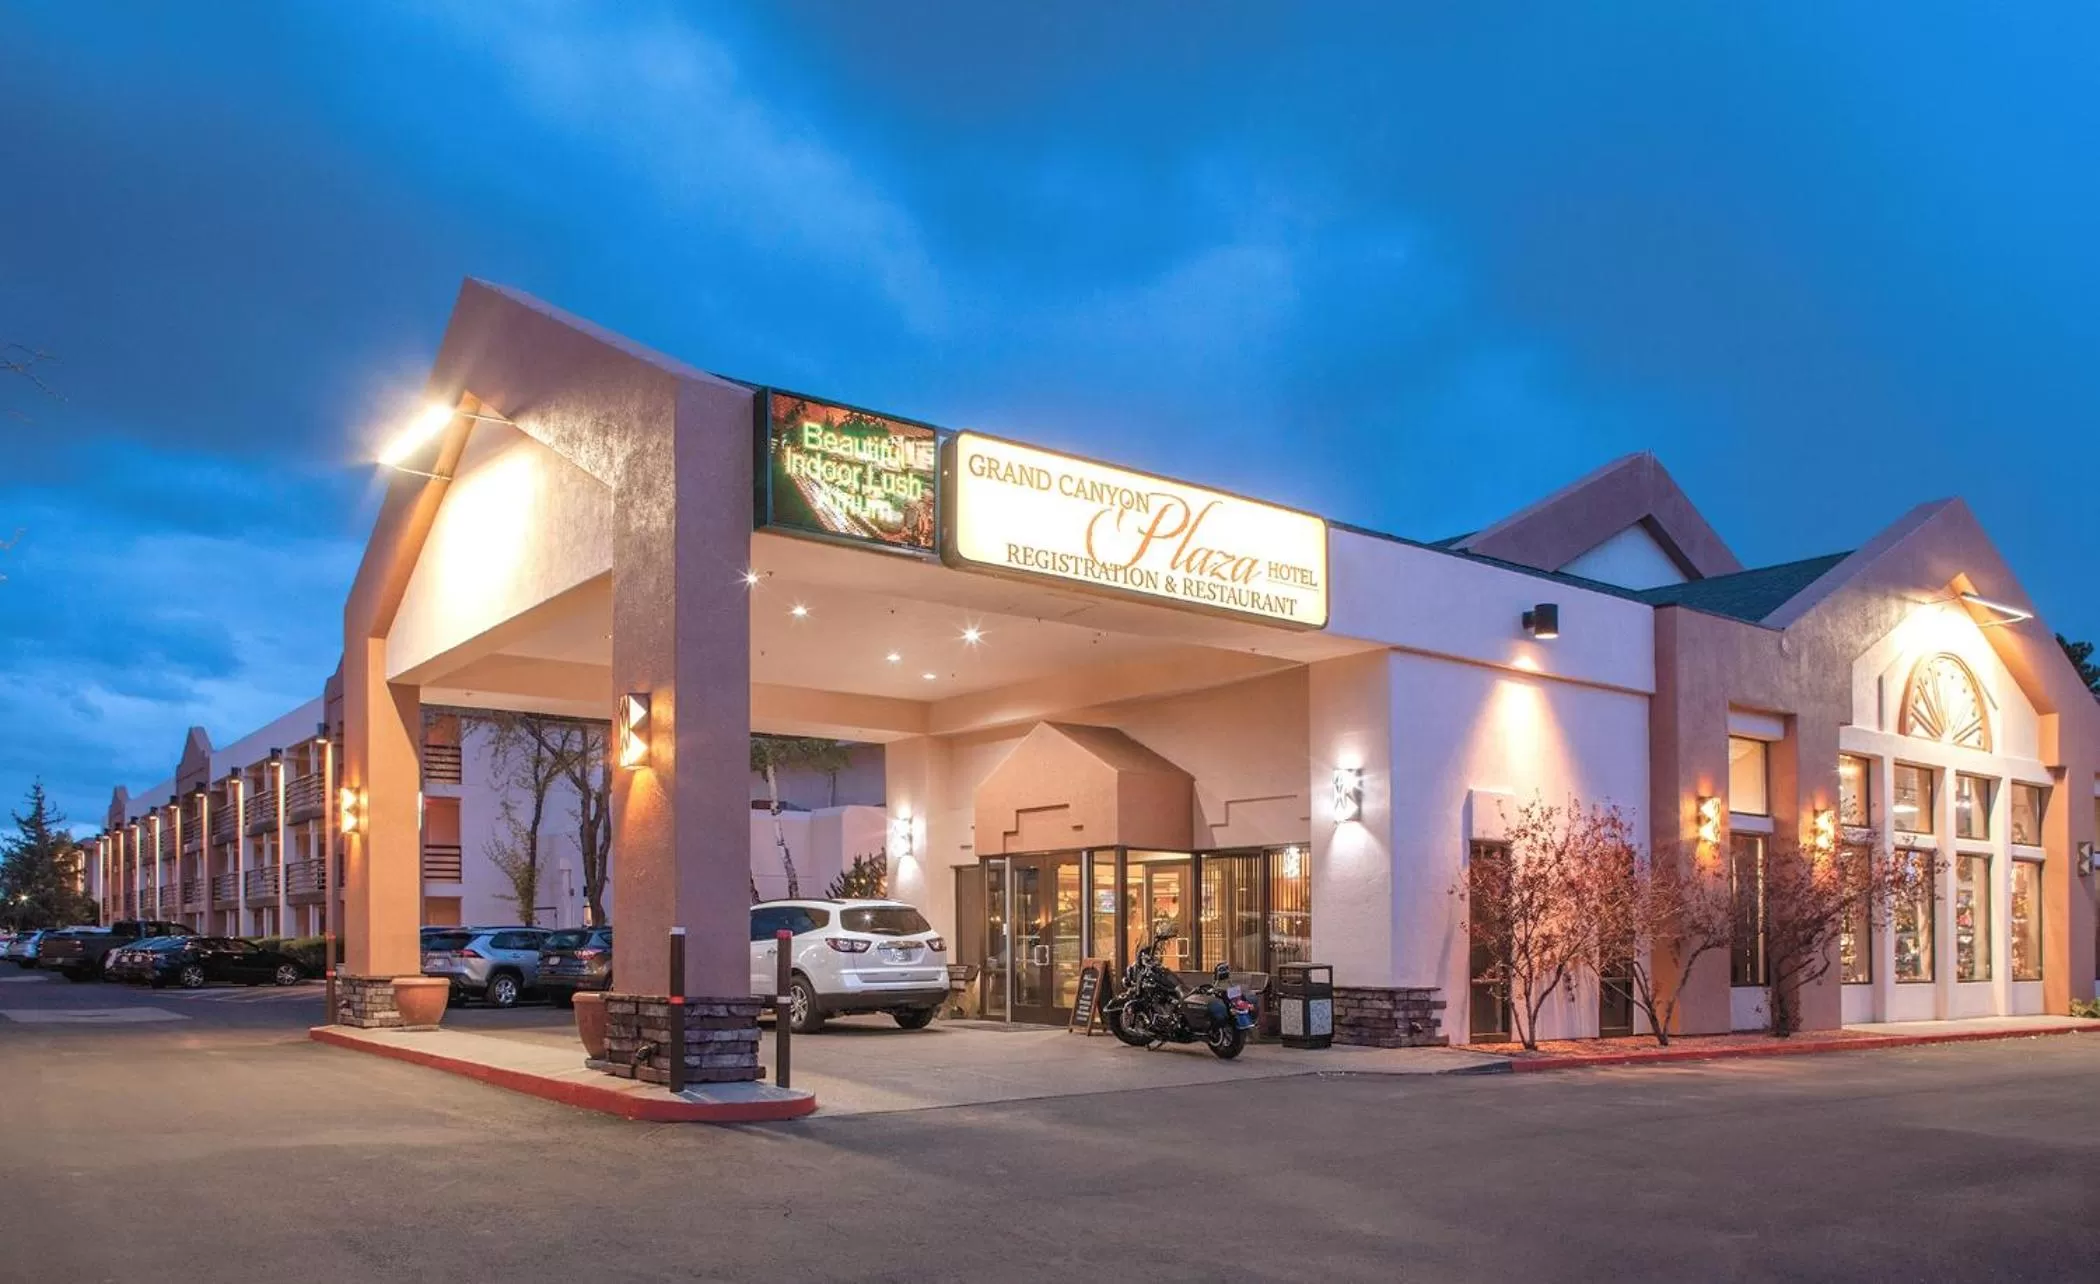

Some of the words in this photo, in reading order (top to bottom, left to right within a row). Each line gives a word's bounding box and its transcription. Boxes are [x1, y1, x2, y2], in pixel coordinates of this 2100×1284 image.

[785, 445, 862, 490] Indoor
[867, 464, 922, 500] Lush
[803, 422, 905, 474] Beautiful
[968, 454, 1052, 492] GRAND
[1059, 474, 1150, 515] CANYON
[1086, 491, 1262, 585] Plaza
[1268, 561, 1318, 587] HOTEL
[1006, 543, 1159, 590] REGISTRATION
[1164, 575, 1177, 594] &
[1182, 576, 1298, 616] RESTAURANT
